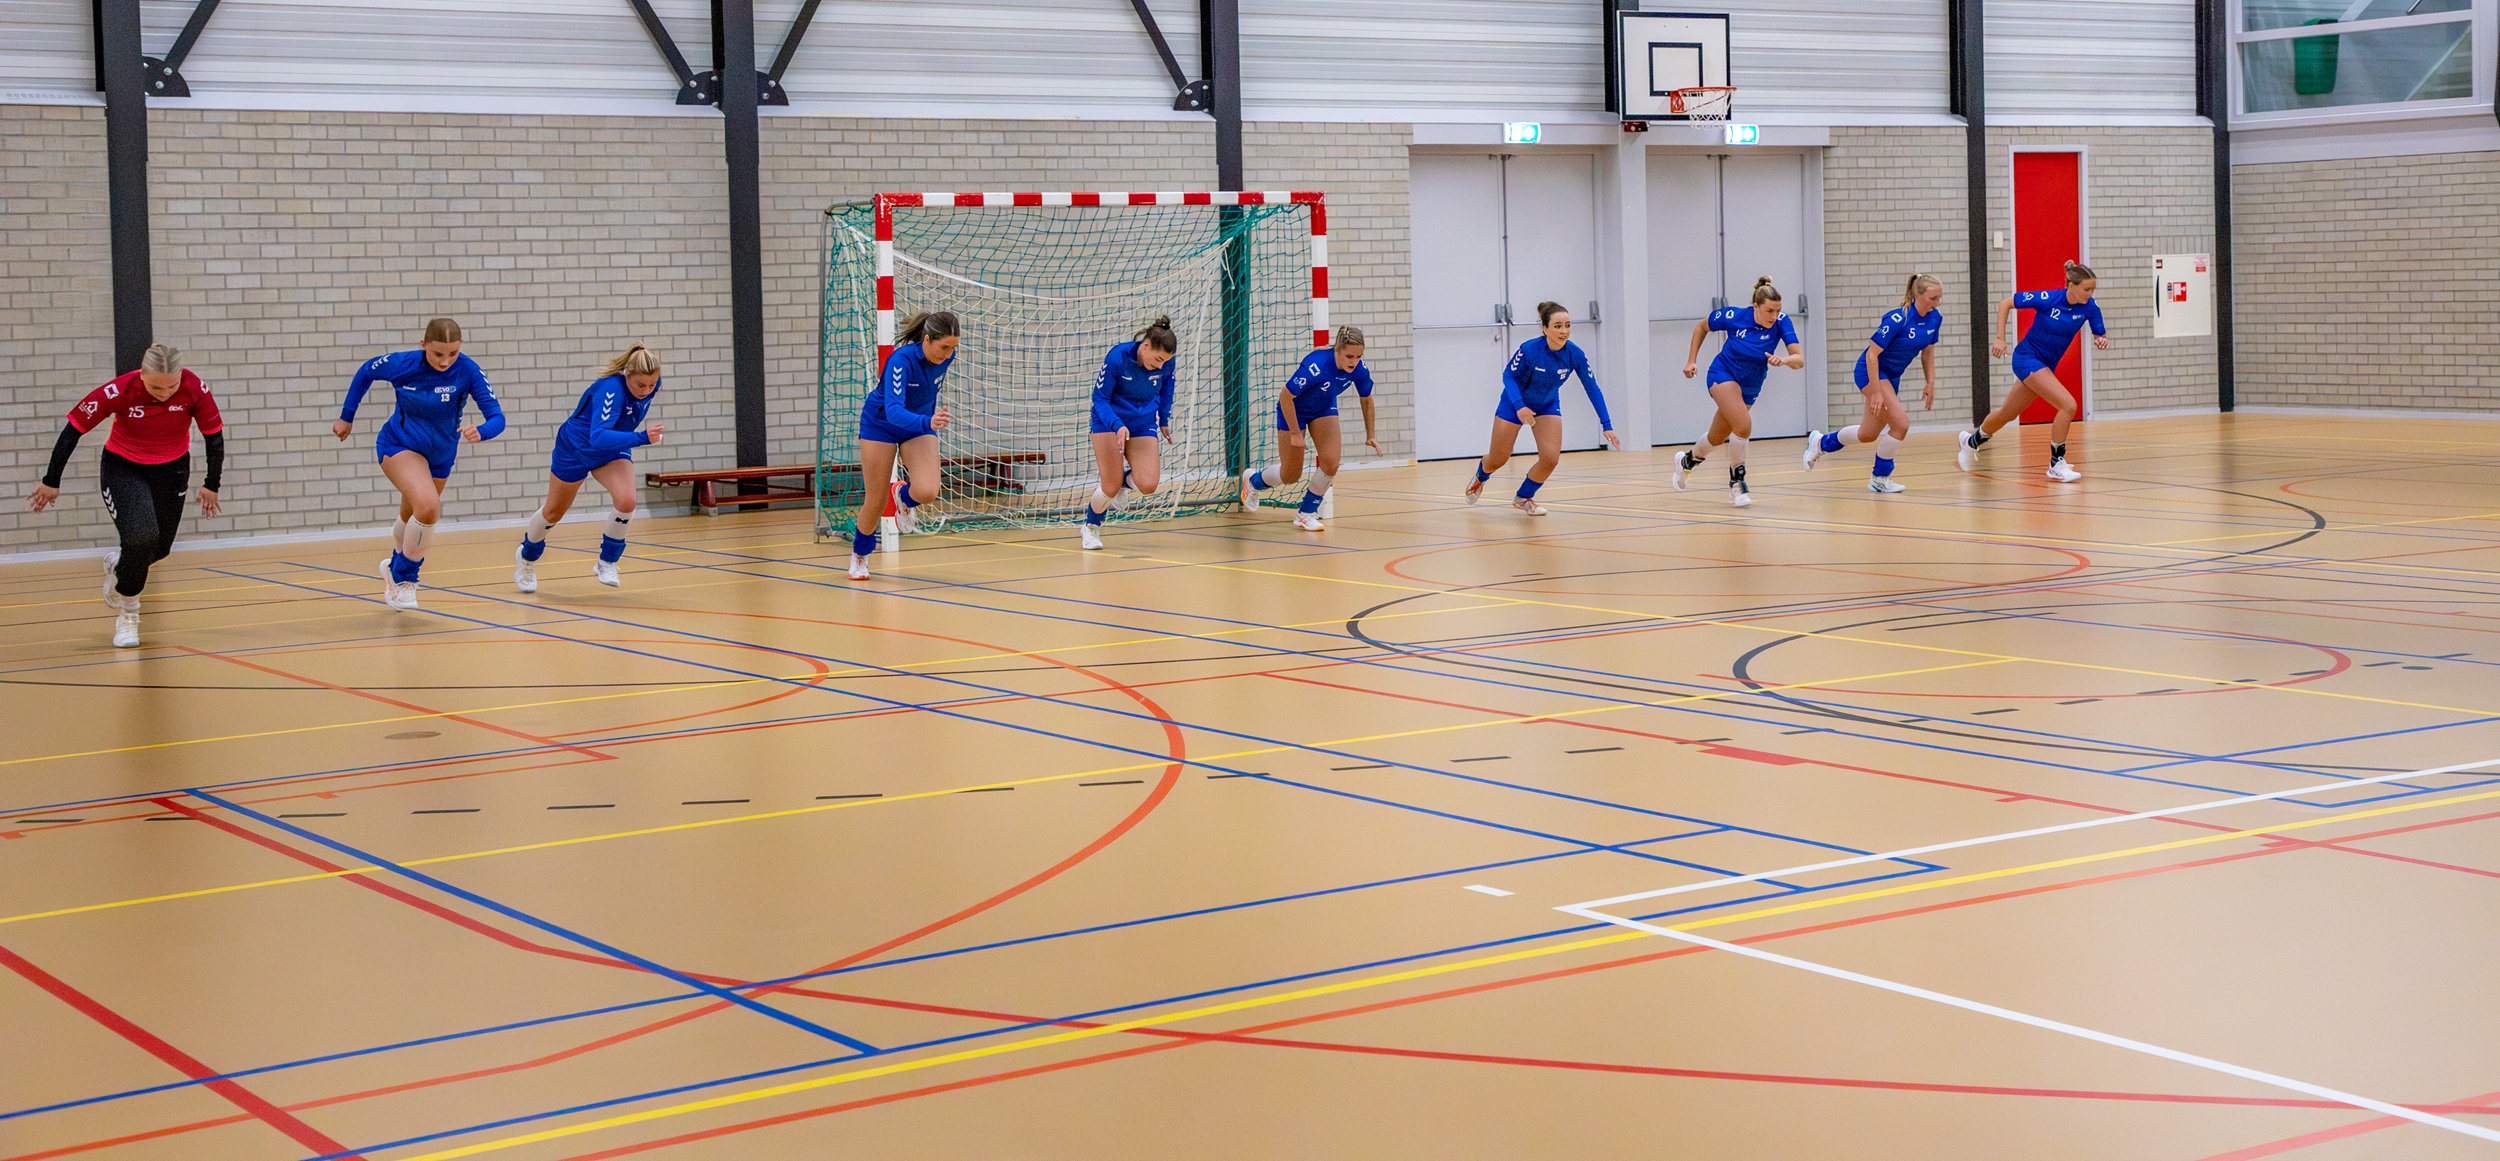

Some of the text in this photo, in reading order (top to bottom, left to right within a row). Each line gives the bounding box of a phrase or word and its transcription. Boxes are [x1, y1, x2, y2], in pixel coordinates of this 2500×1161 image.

[2050, 308, 2060, 320] 12
[1736, 328, 1747, 338] 14
[1908, 328, 1916, 338] 5
[1320, 382, 1330, 392] 2
[440, 394, 450, 402] 13
